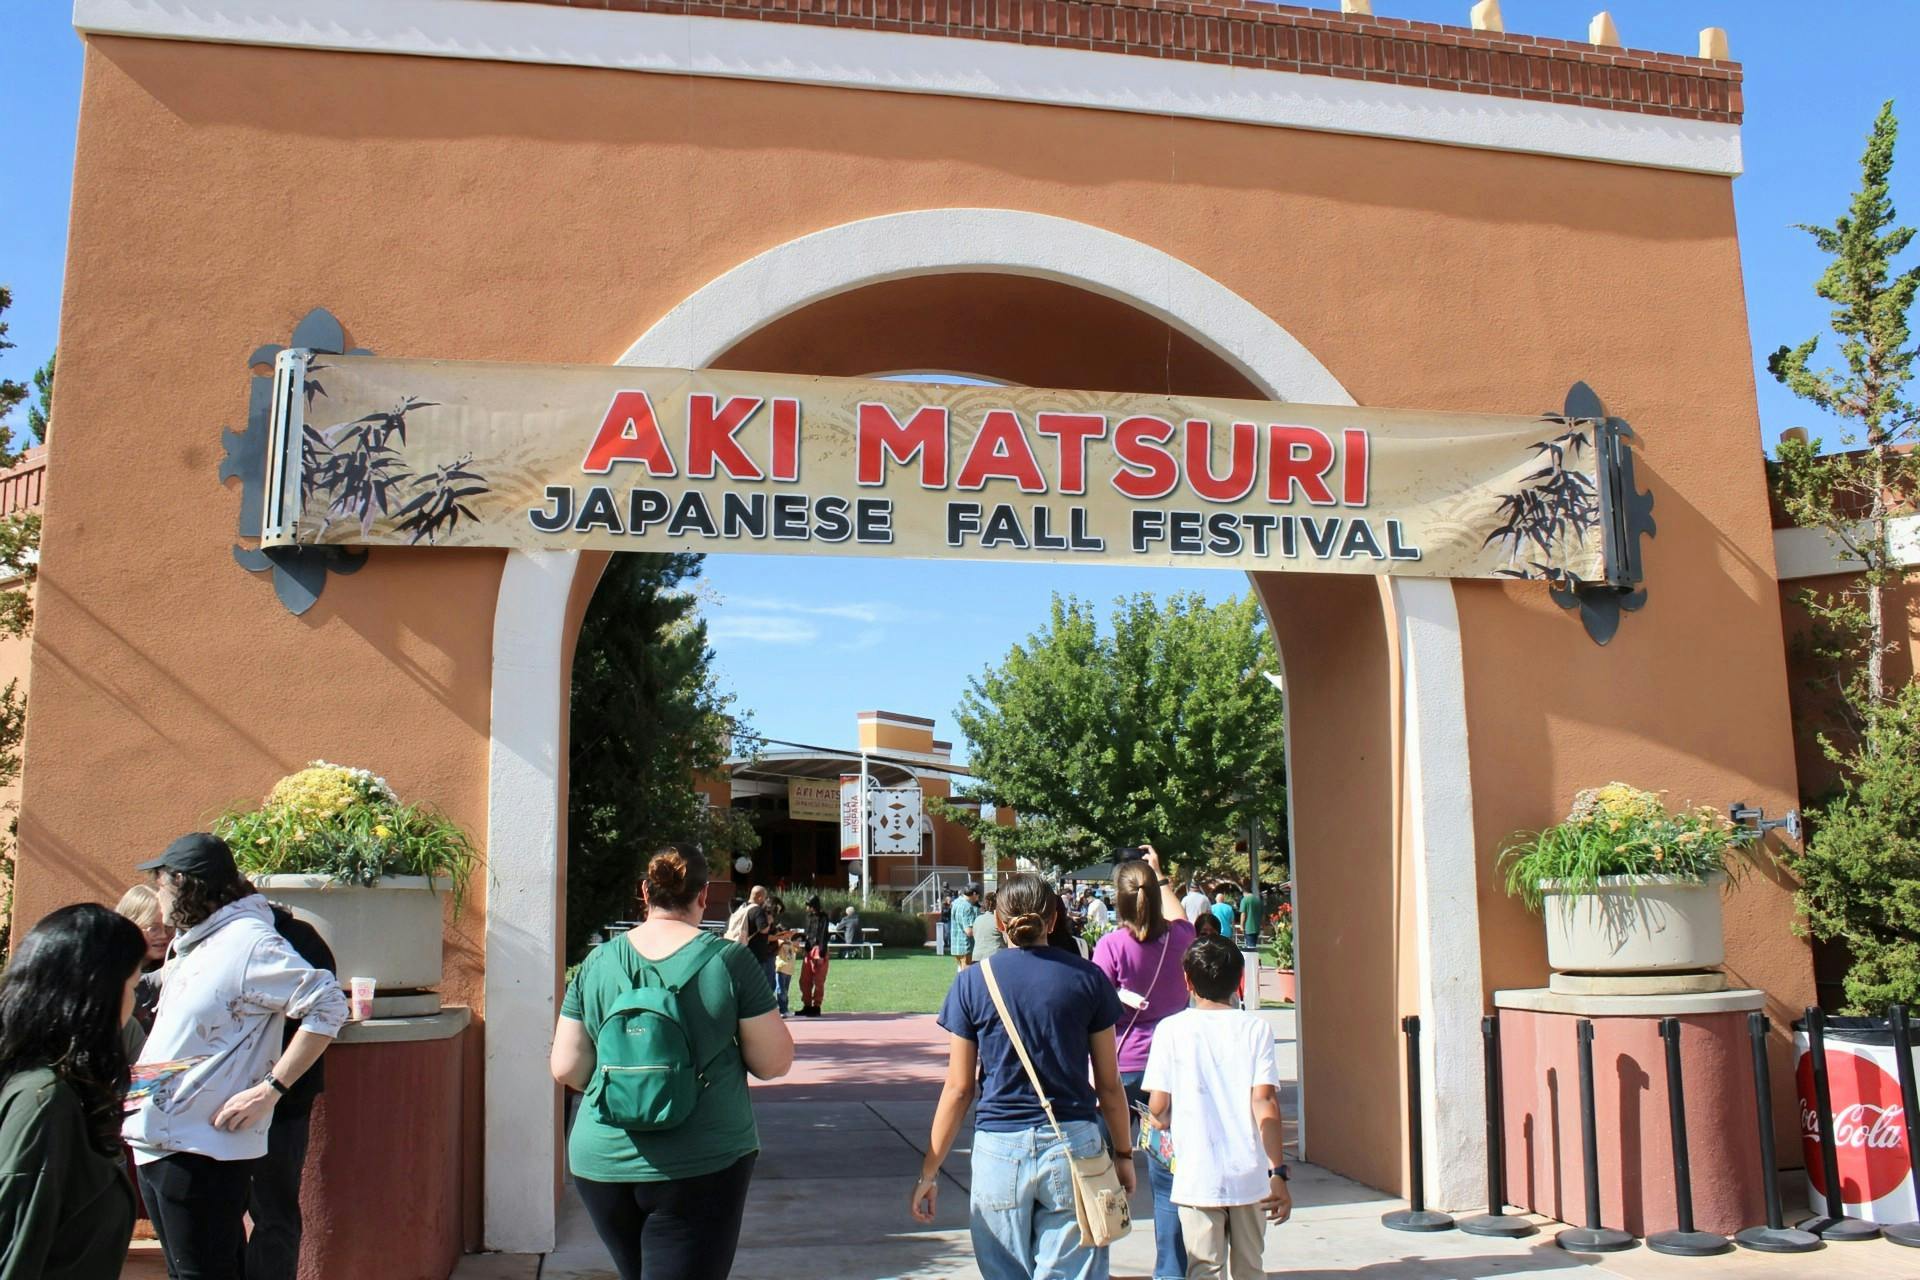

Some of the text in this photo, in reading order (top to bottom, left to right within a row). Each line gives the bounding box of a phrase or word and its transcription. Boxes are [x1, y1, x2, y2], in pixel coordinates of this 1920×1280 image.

[582, 390, 1369, 507] AKI MATSURI
[529, 485, 1420, 560] JAPANESE FALL FESTIVAL
[843, 802, 851, 827] VILLA
[851, 795, 859, 833] HISPANA
